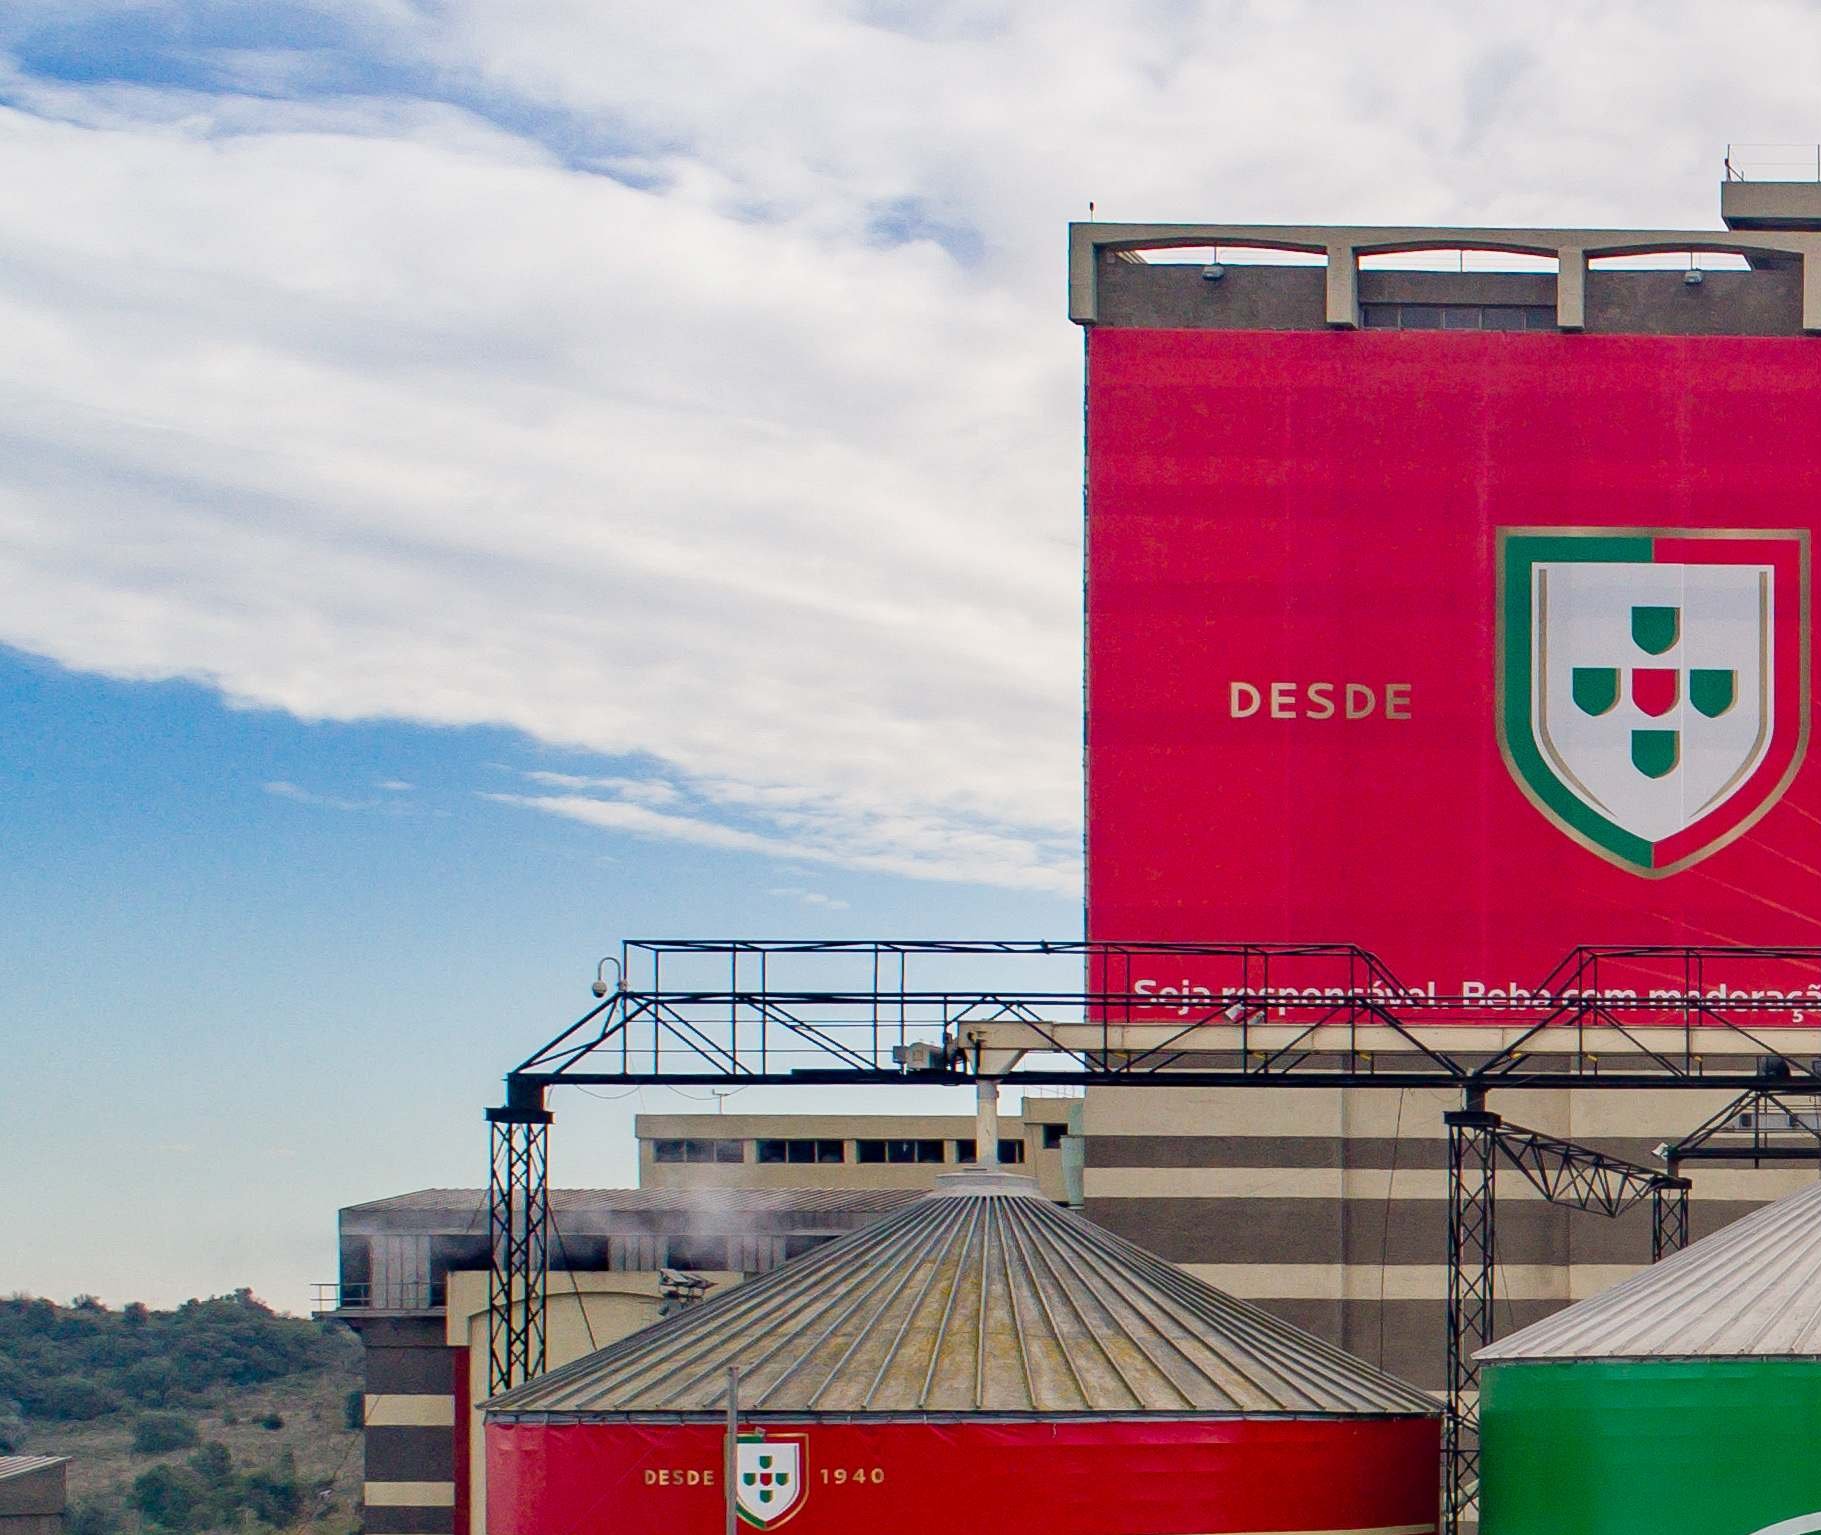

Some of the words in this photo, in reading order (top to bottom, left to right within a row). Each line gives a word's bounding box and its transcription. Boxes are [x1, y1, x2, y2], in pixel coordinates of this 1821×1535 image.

[1228, 680, 1414, 721] DESDE
[643, 1467, 715, 1487] DESDE
[819, 1466, 886, 1485] 1940
